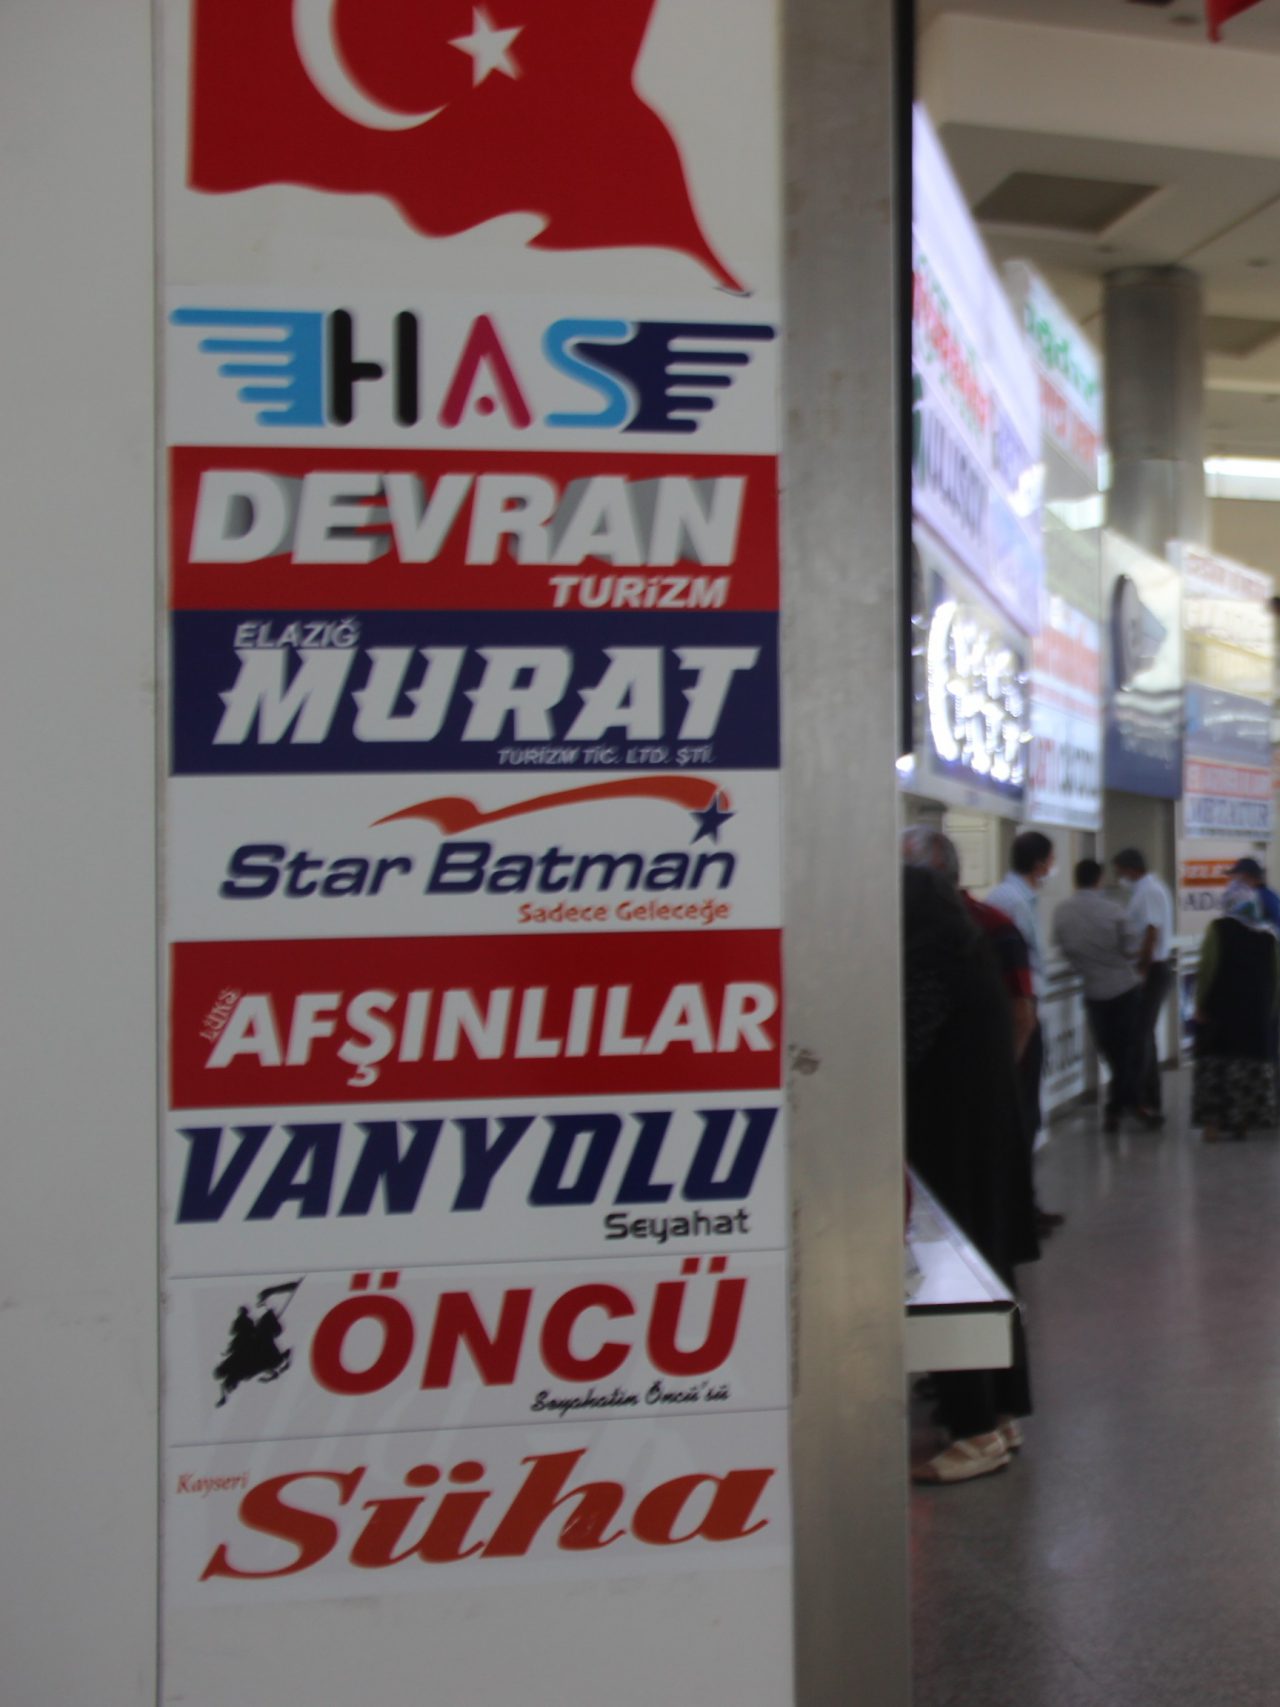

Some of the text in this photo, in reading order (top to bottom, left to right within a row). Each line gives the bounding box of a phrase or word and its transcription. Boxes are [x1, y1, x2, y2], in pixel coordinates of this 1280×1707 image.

[328, 308, 630, 428] HAS
[190, 470, 745, 567] DEVRAN
[233, 617, 361, 648] ELAZIĞ
[212, 647, 760, 745] MURAT
[219, 841, 738, 900] Star Batman
[518, 898, 730, 924] Sadece Geleceğe
[175, 1107, 780, 1224] VANYOLU
[604, 1208, 750, 1244] Seyahat
[310, 1256, 747, 1396] ÖNCÜ
[176, 1469, 250, 1496] Kayseri
[198, 1448, 776, 1584] Süha
